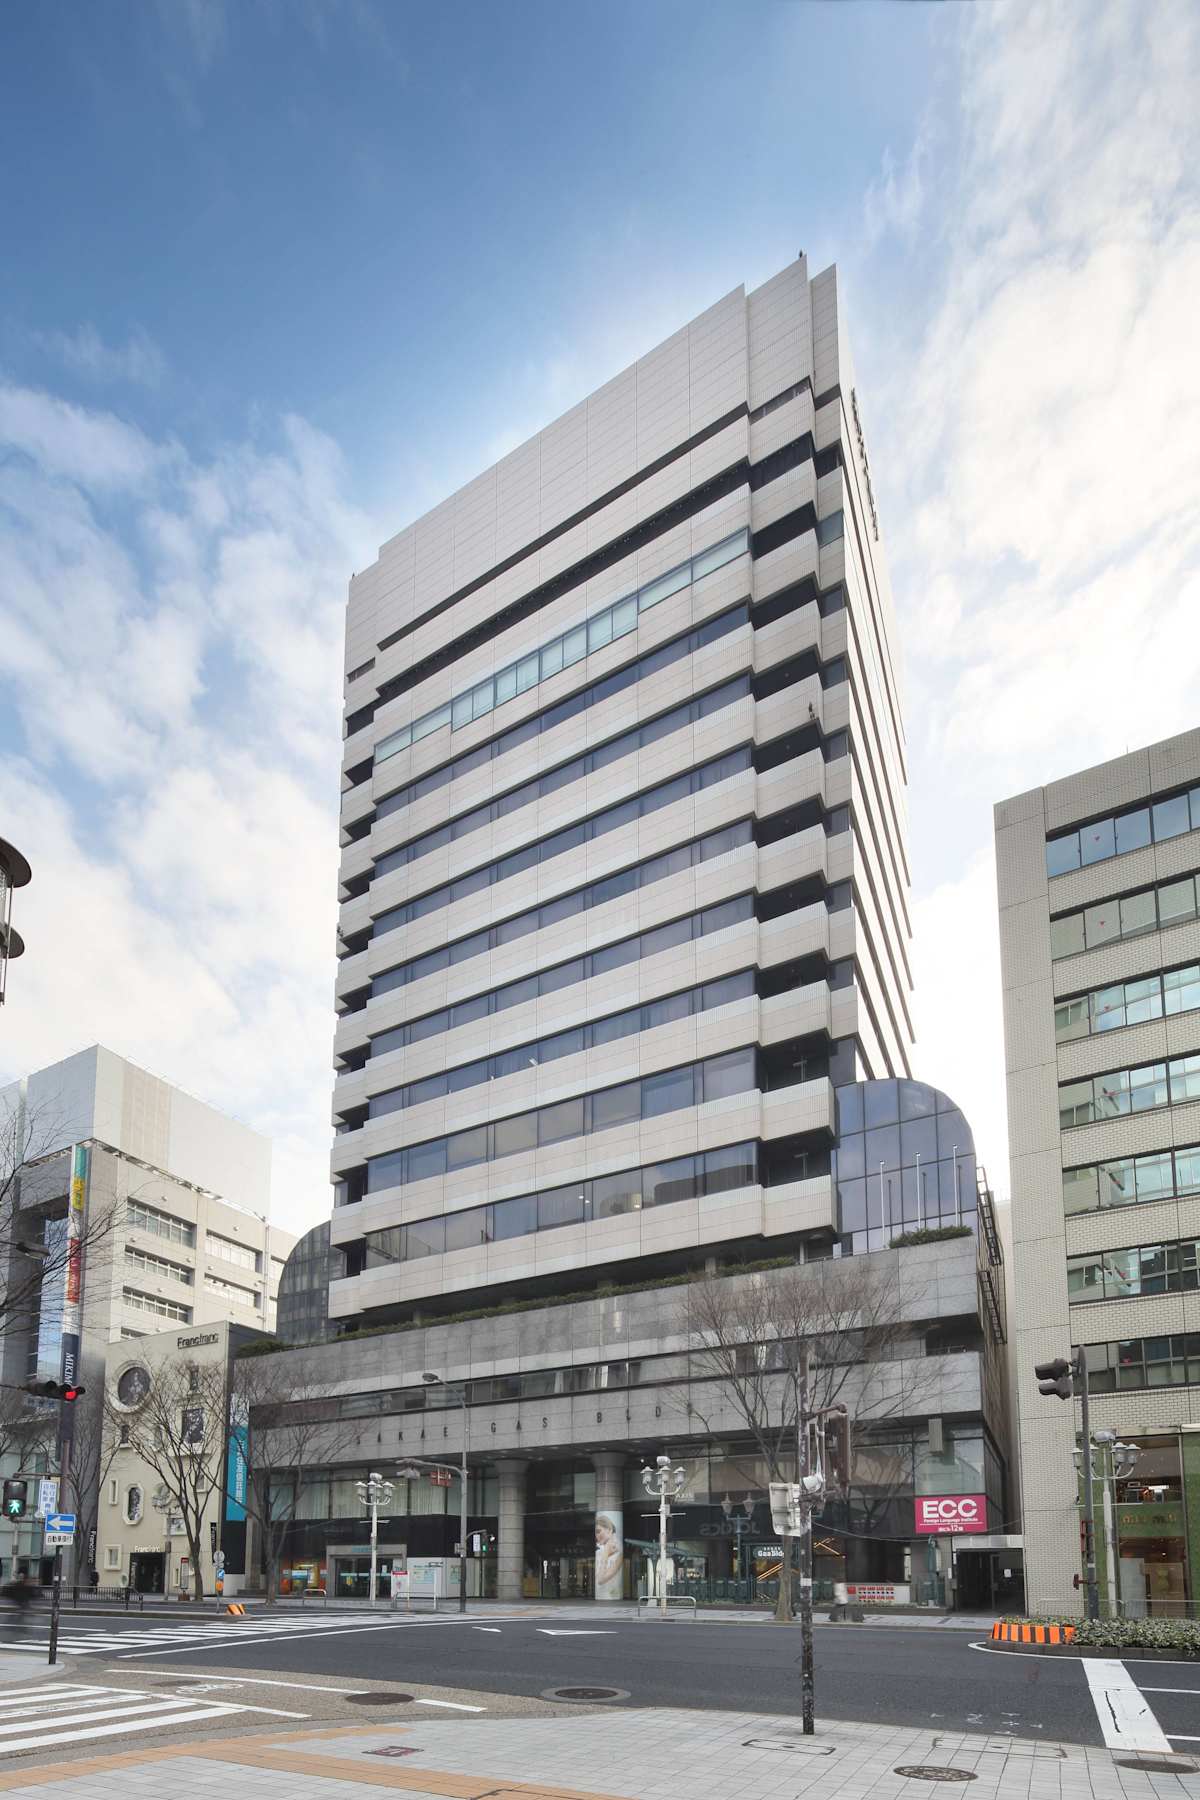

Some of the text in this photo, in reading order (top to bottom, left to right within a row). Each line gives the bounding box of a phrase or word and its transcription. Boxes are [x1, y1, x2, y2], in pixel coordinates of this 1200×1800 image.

[64, 1353, 75, 1384] MIKIM
[490, 1416, 549, 1434] GAS
[922, 1499, 977, 1519] ECC
